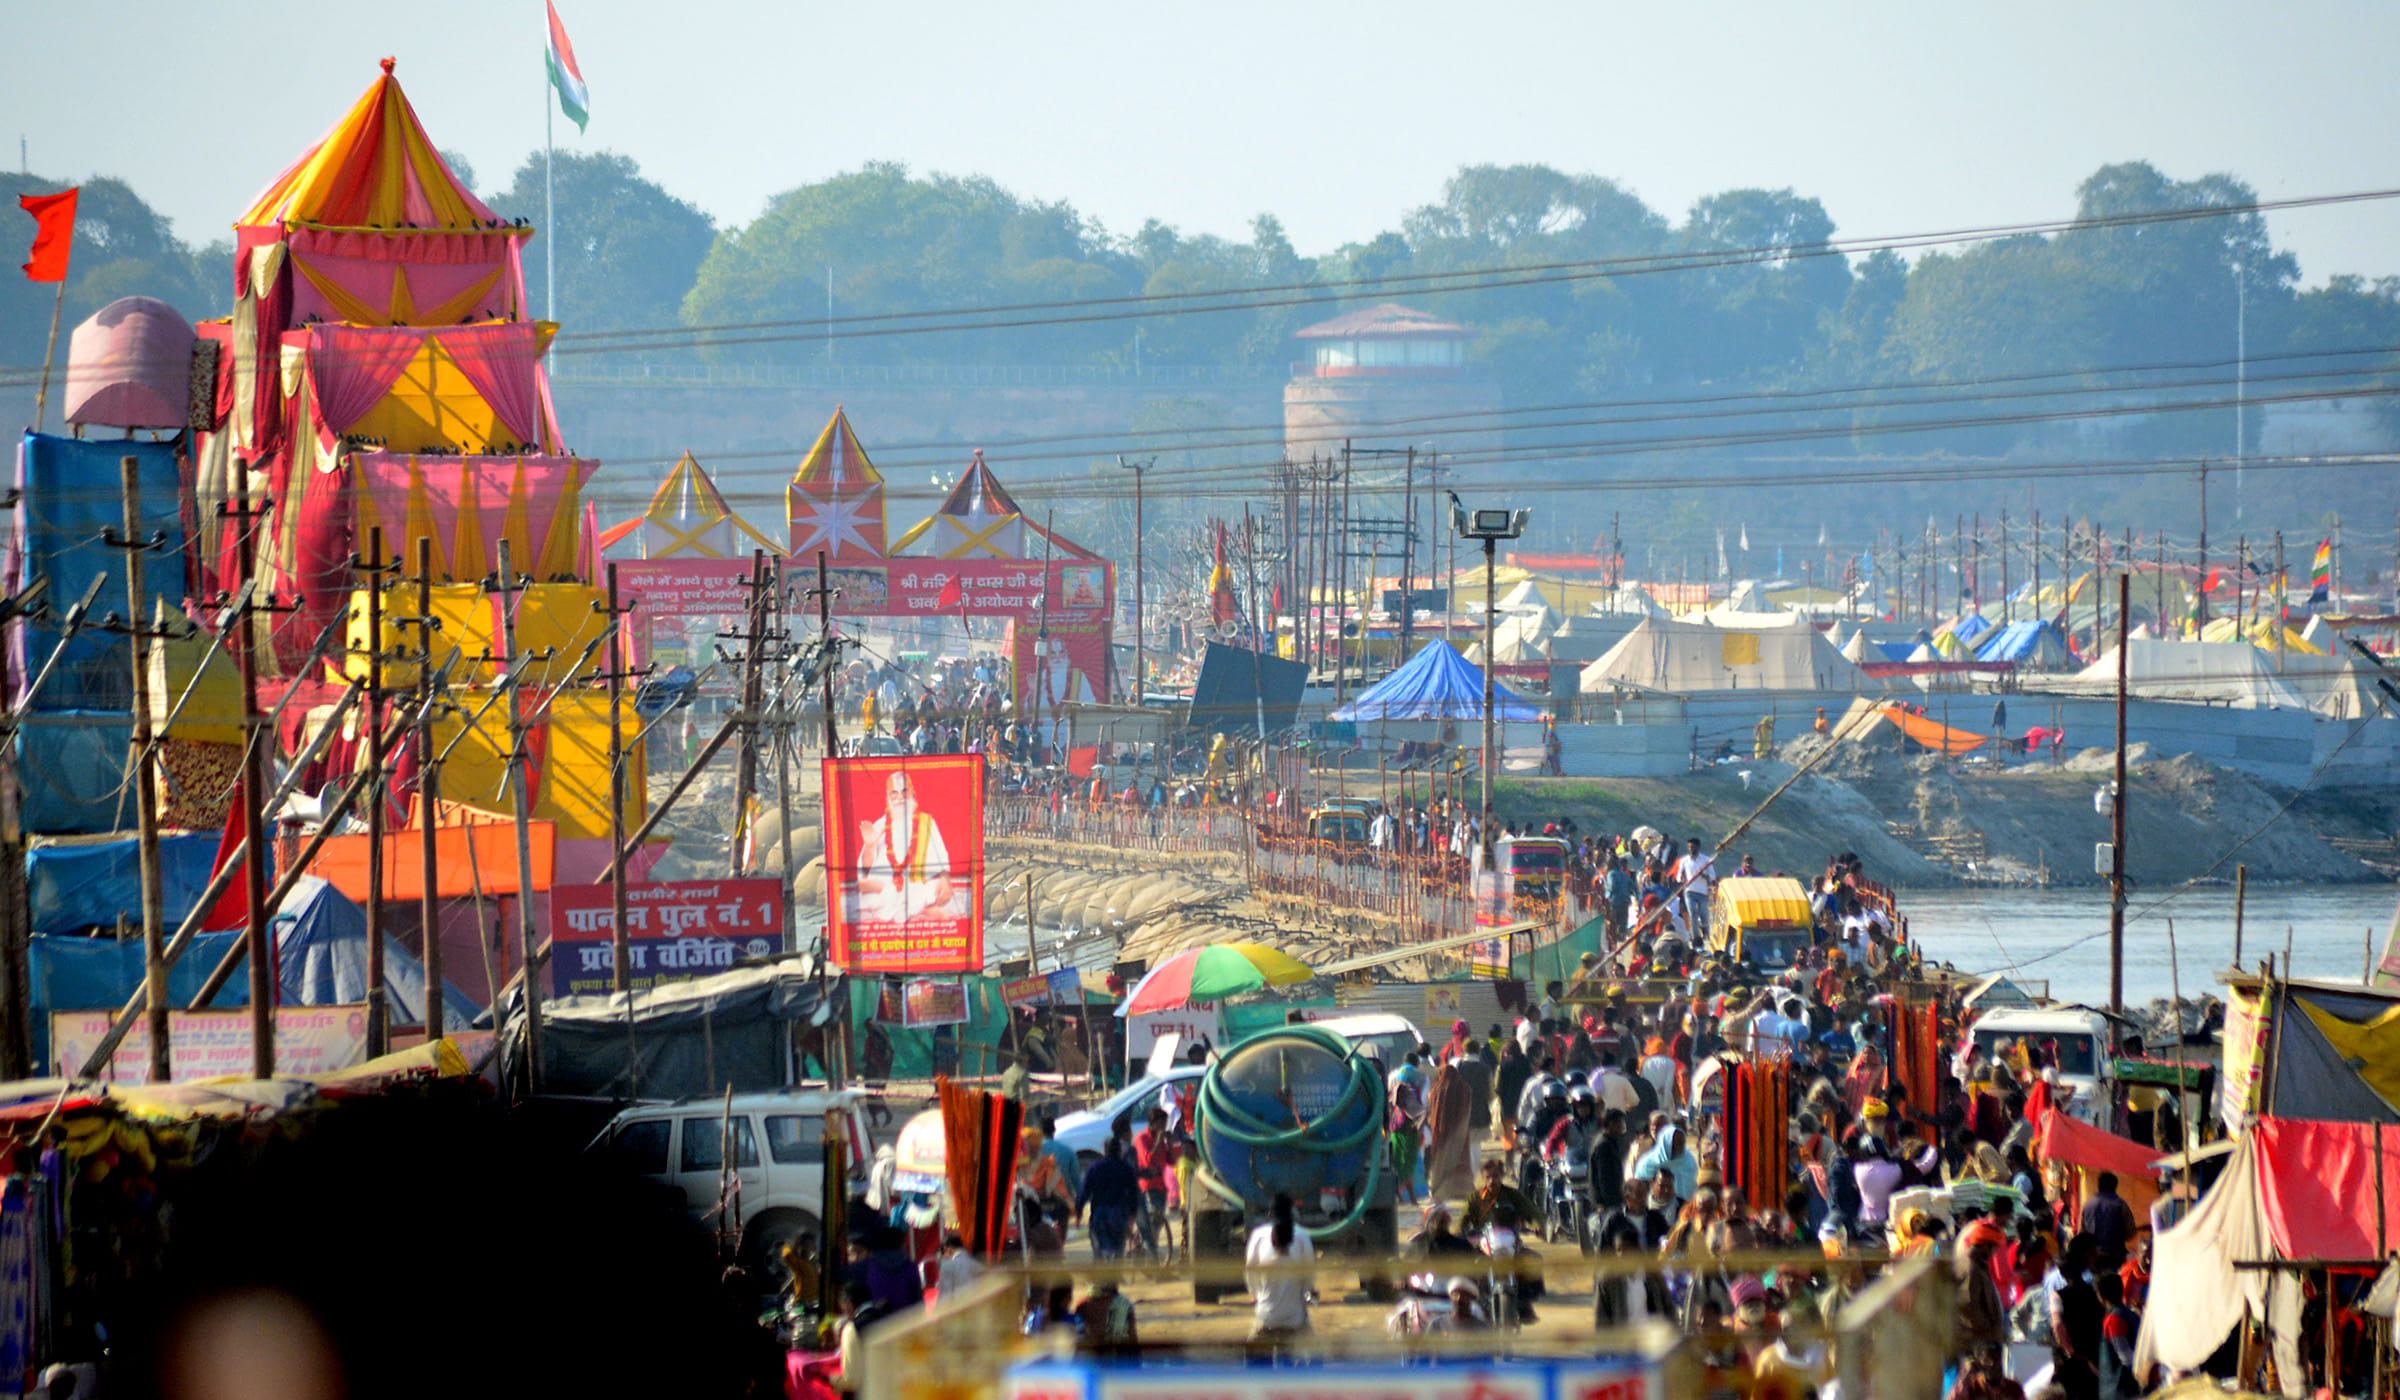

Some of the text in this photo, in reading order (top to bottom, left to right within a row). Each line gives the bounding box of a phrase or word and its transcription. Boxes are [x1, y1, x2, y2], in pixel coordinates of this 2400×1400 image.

[658, 904, 708, 936] पुल
[716, 897, 749, 928] नं.
[758, 902, 772, 926] 1
[656, 936, 736, 968] वर्जित
